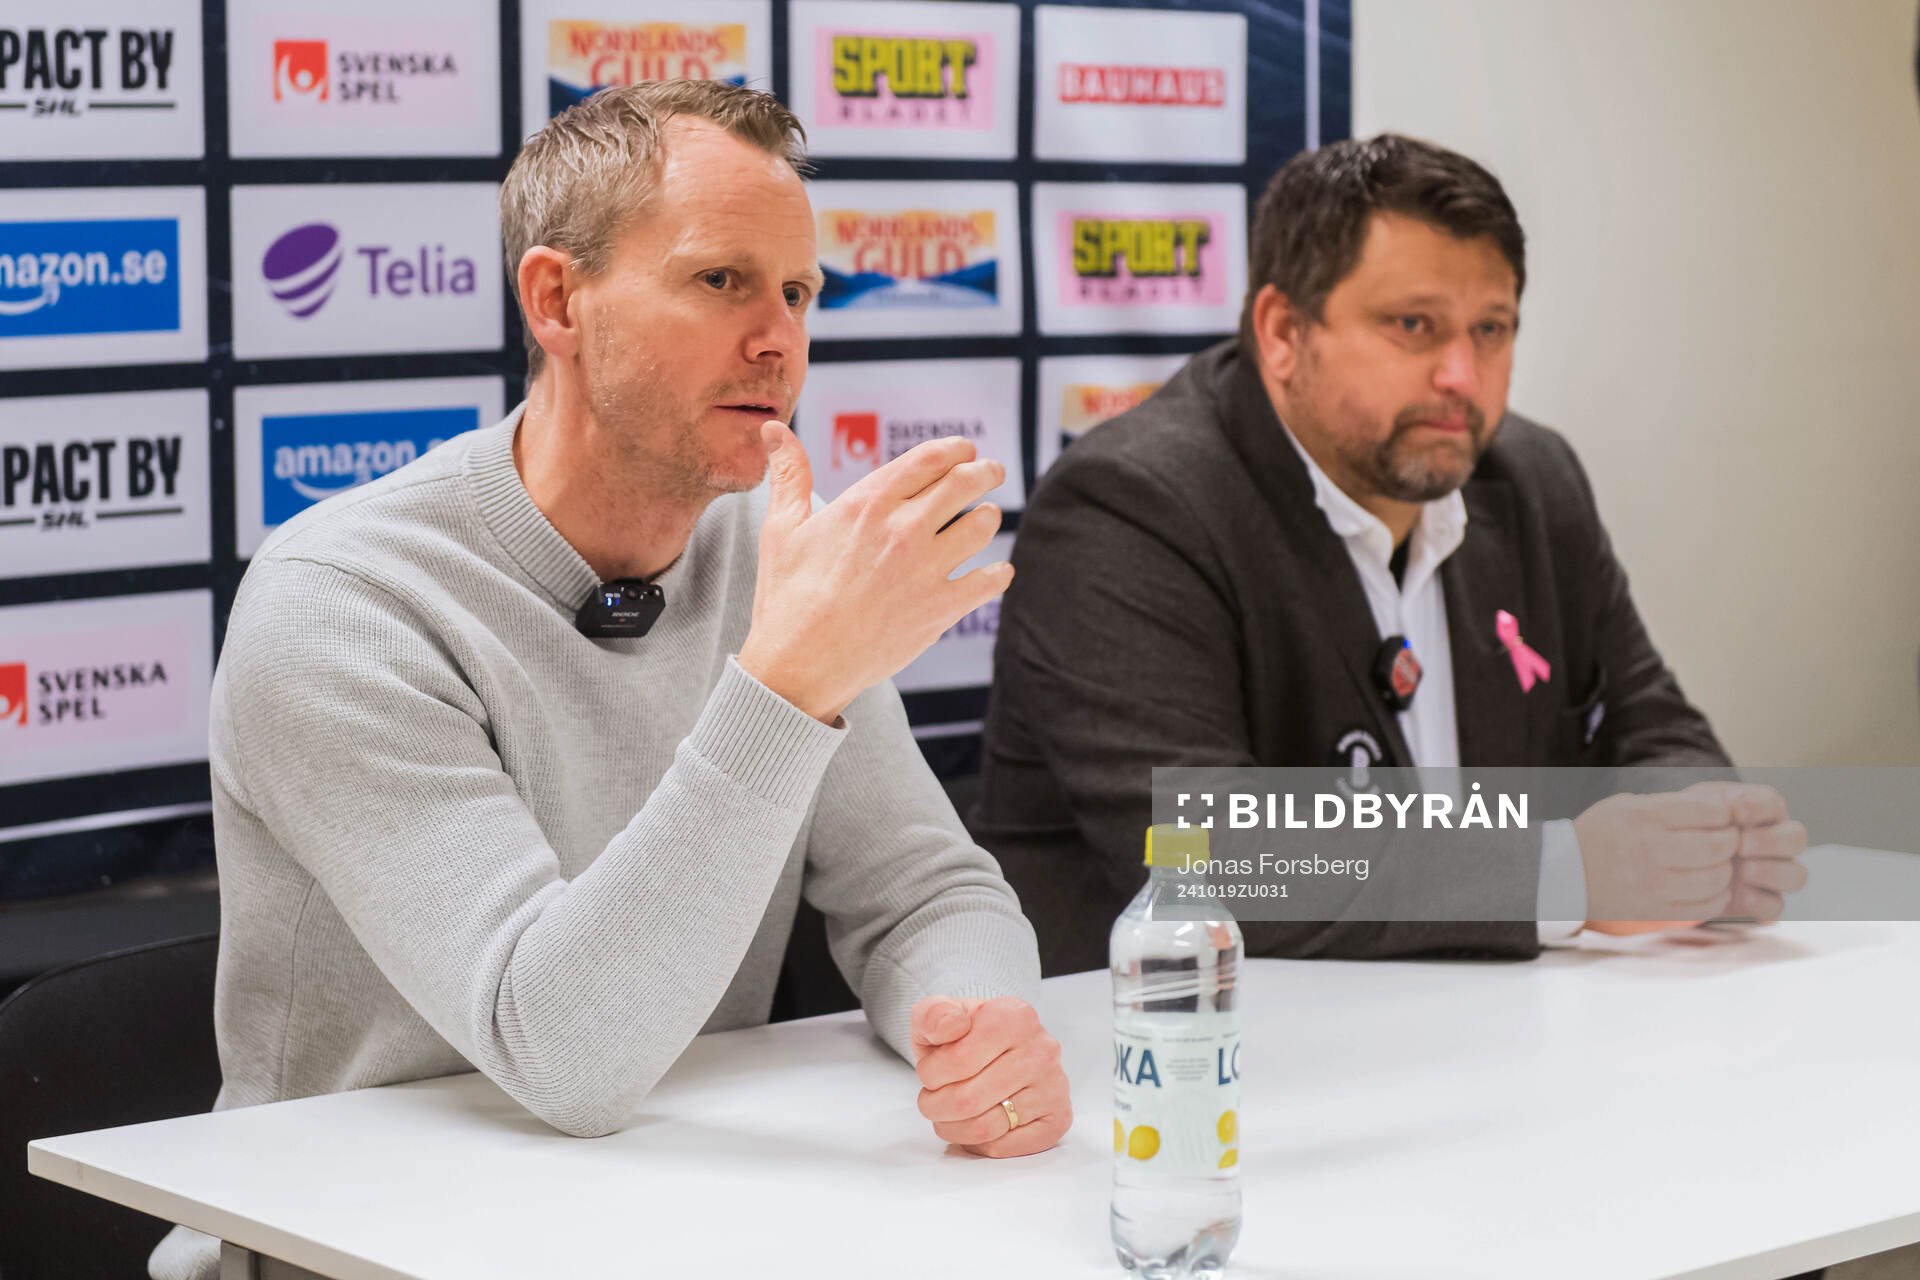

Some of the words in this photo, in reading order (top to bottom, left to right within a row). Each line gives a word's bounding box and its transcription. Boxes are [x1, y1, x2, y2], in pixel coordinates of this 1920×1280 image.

[120, 30, 174, 90] BY
[338, 53, 457, 75] SVENSKA
[833, 36, 976, 98] SPORT
[338, 81, 400, 102] SPEL
[1060, 64, 1225, 106] BAUHAUS
[357, 245, 476, 296] Telia
[1073, 219, 1211, 278] SPORT
[128, 434, 182, 498] BY
[37, 662, 167, 693] SVENSKA
[38, 700, 105, 724] SPEL
